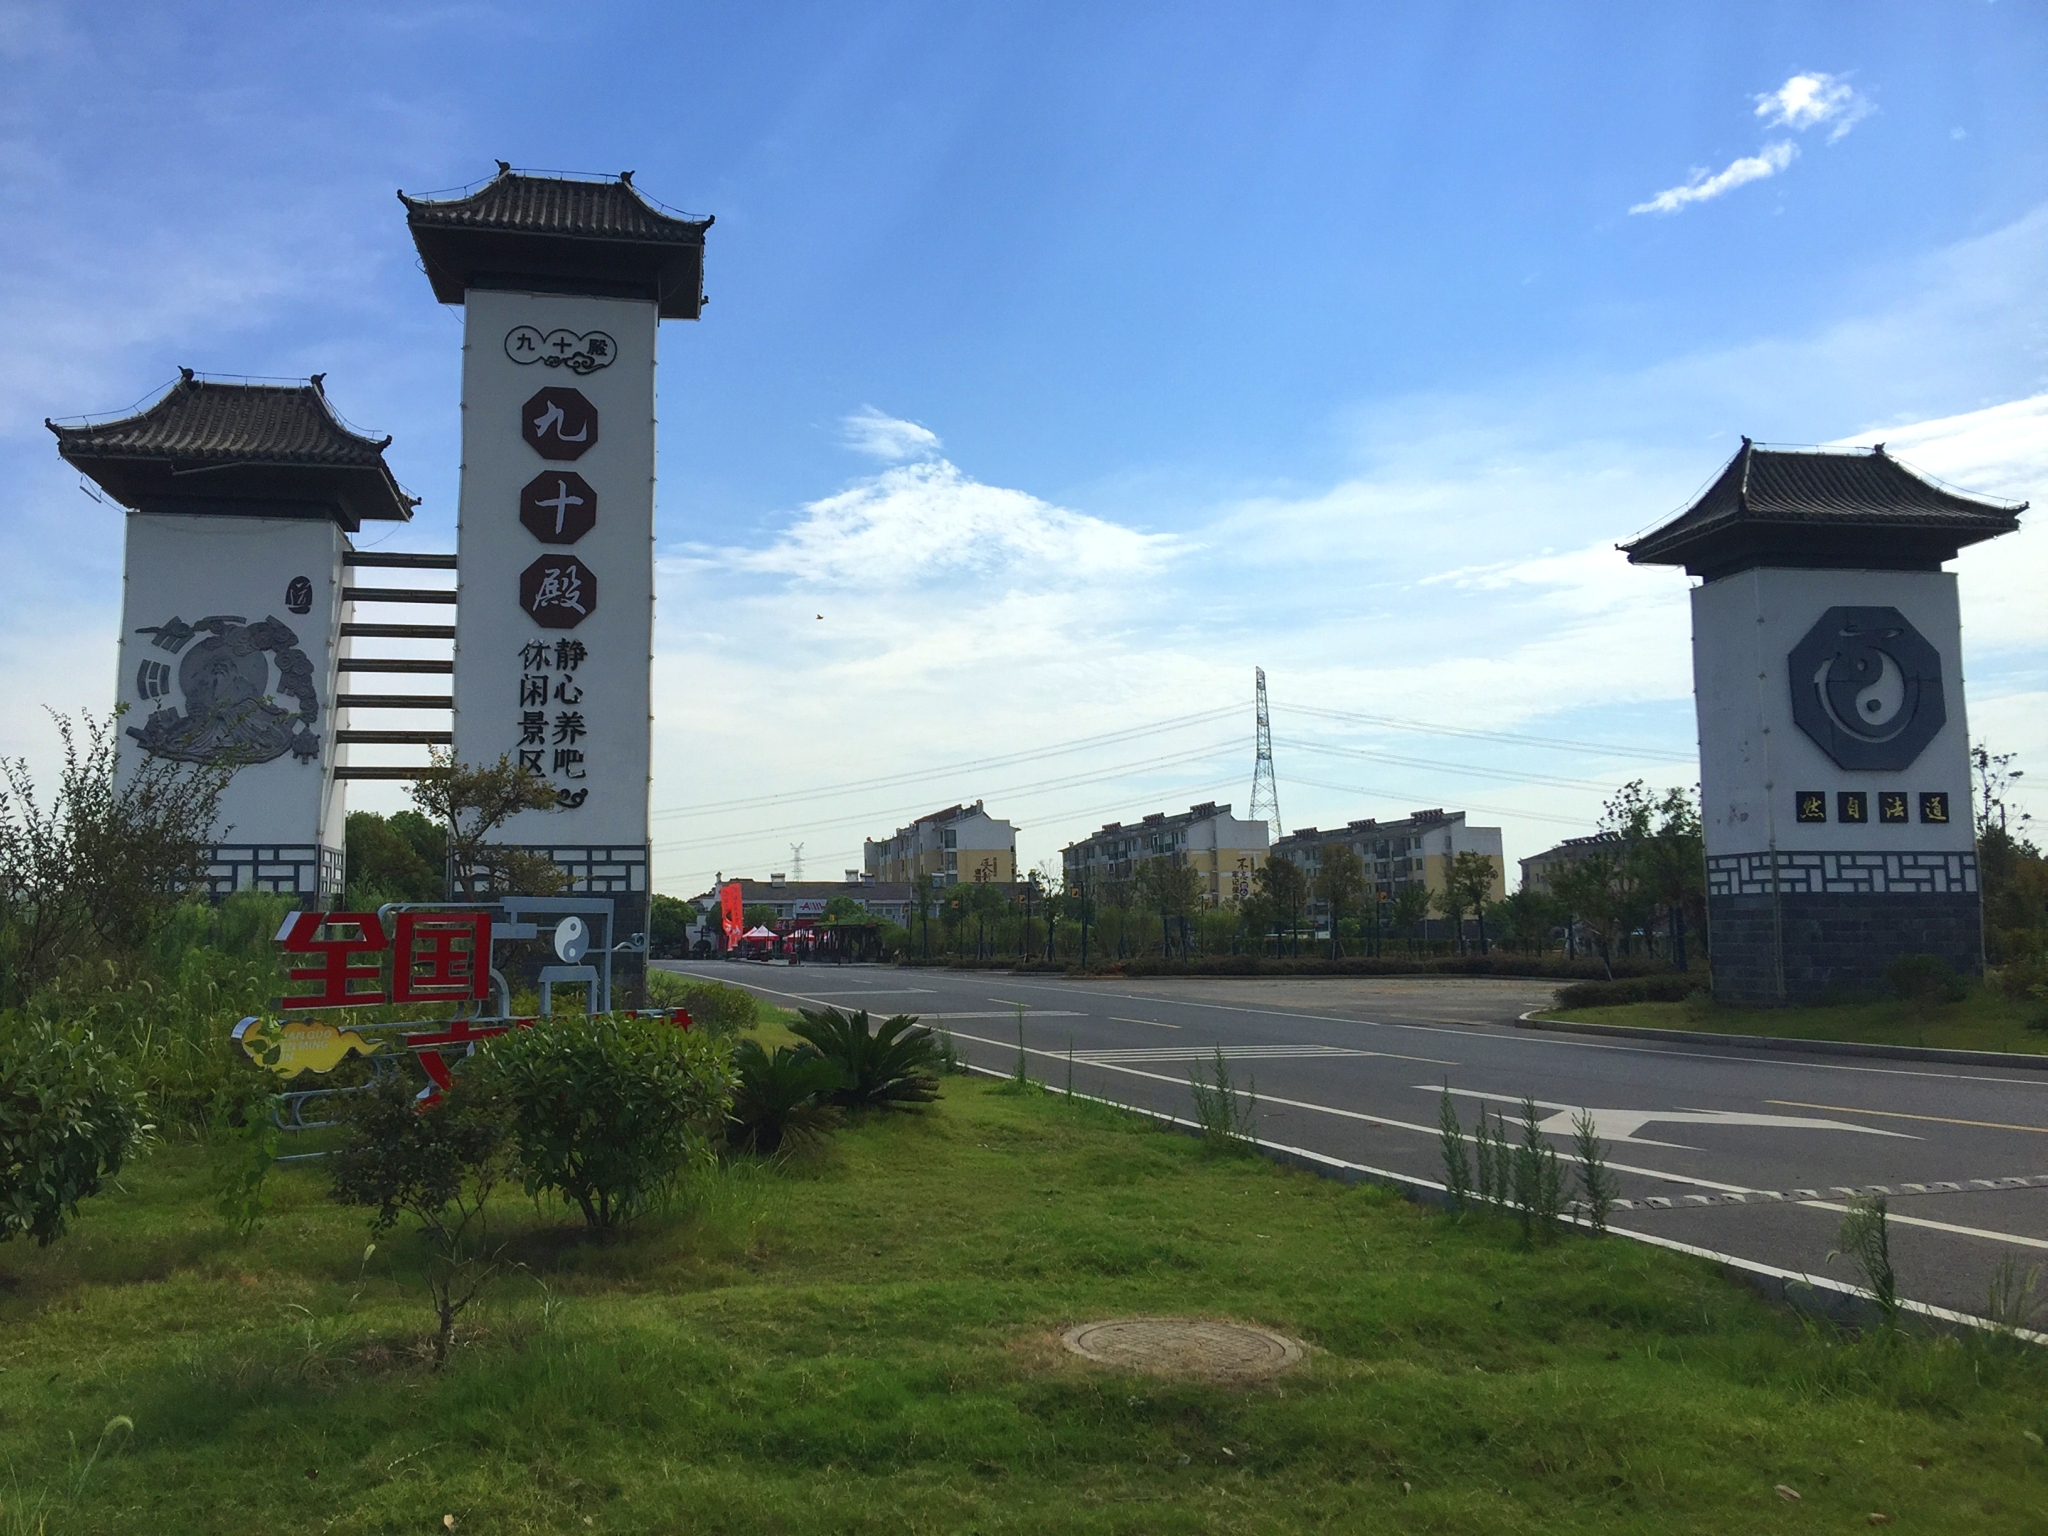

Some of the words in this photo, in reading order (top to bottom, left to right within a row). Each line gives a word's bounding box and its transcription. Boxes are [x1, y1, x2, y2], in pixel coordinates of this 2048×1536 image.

[516, 333, 608, 356] 九十殿
[533, 399, 588, 615] 九十殿
[516, 637, 552, 778] 休闲景区
[552, 637, 588, 779] 静心养吧
[274, 911, 492, 1010] 全国
